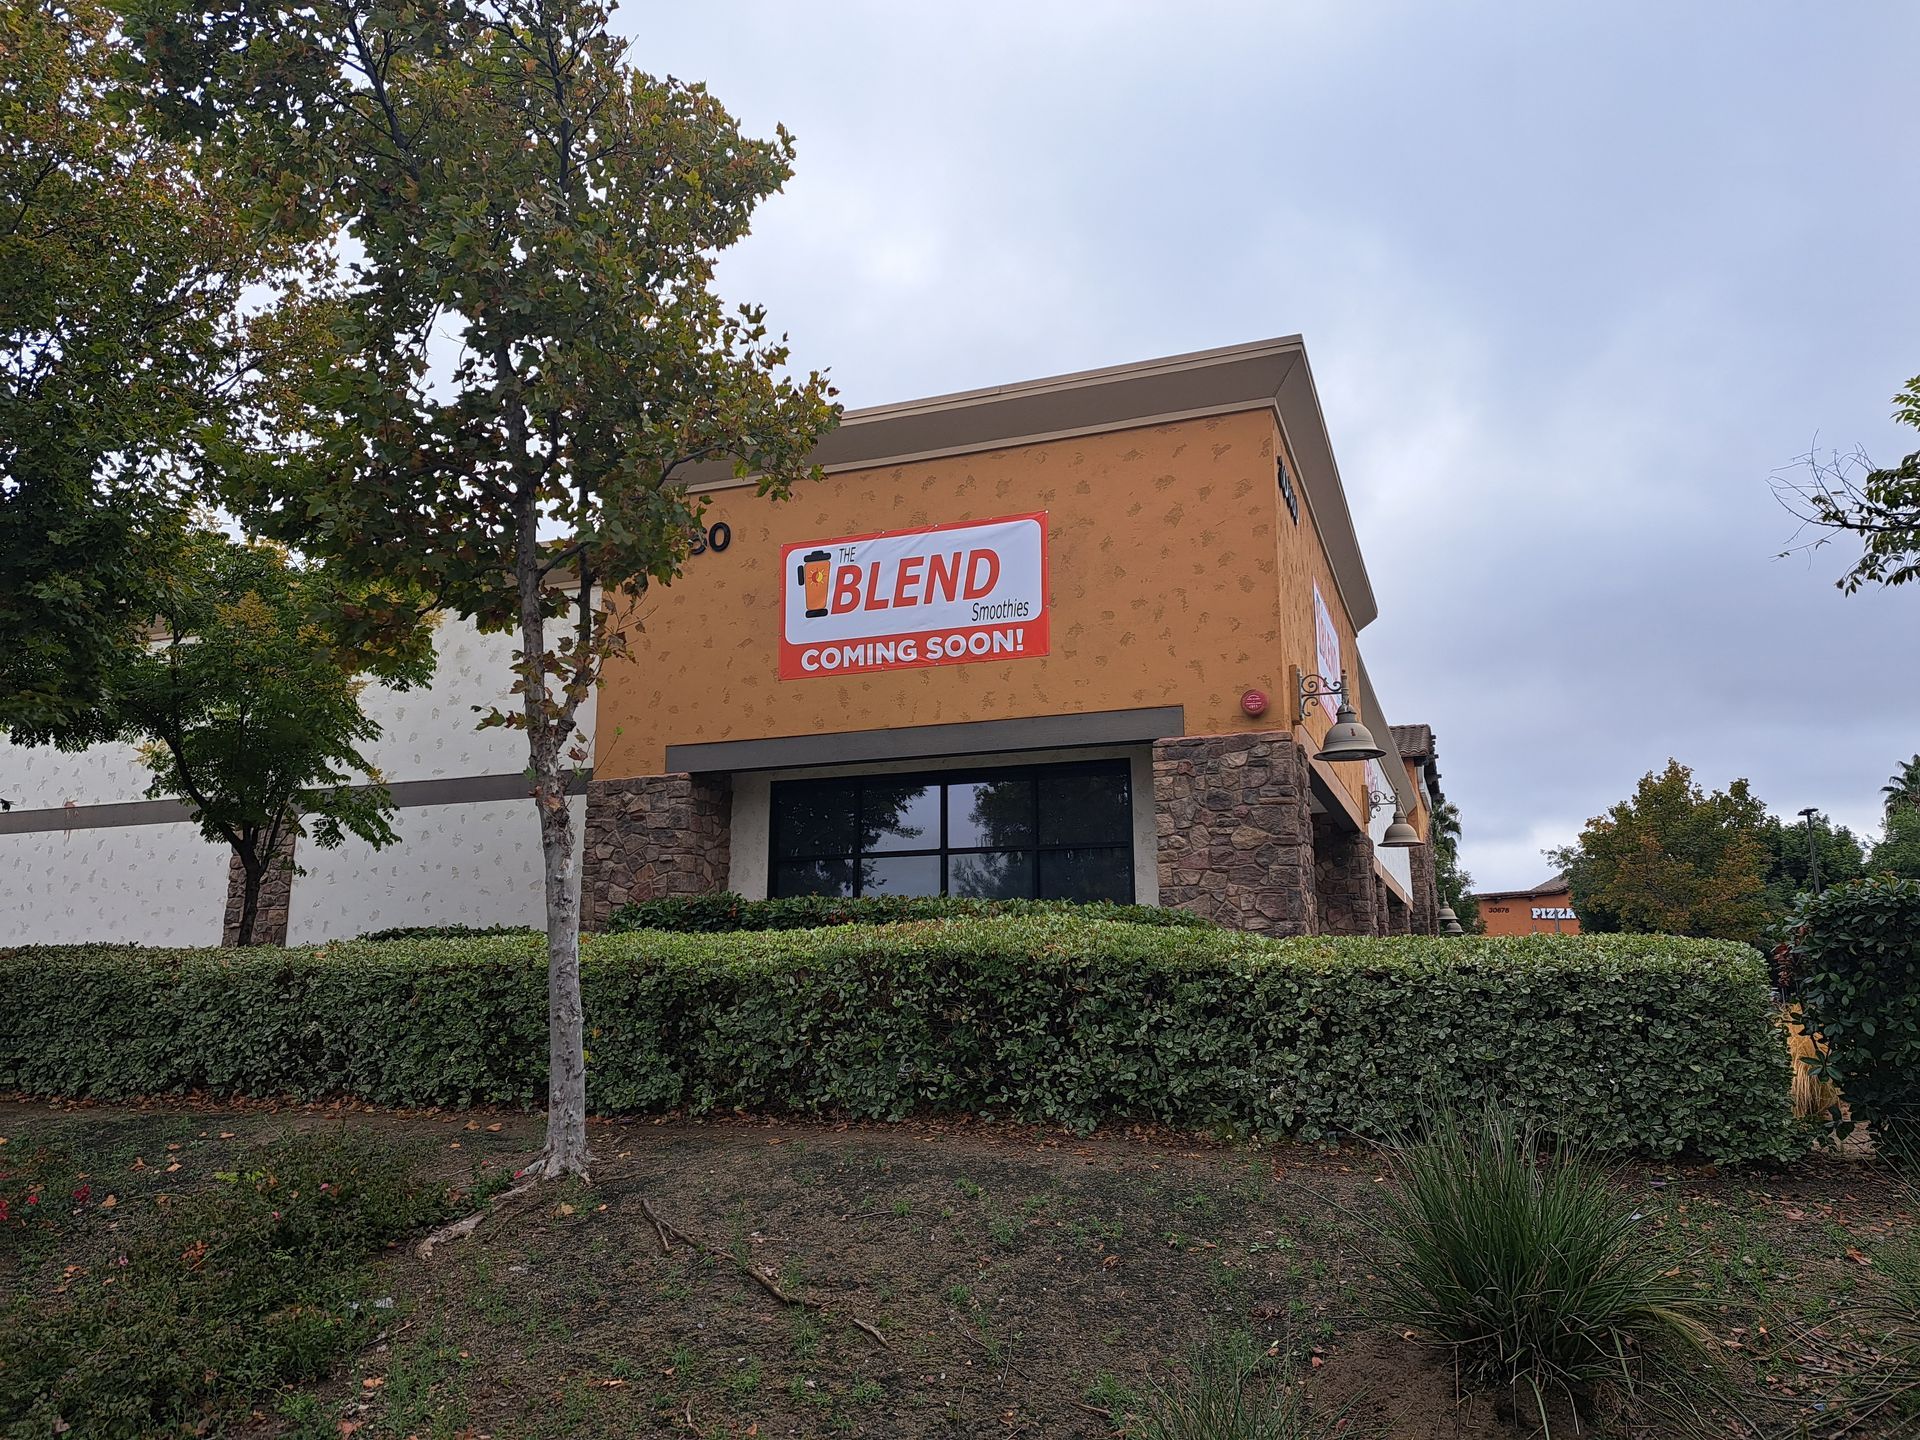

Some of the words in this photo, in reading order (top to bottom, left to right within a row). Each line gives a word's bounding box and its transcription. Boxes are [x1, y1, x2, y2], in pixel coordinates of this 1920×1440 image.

[839, 547, 856, 563] THE
[831, 548, 1000, 615] BLEND
[971, 598, 1029, 621] Smoothies
[801, 639, 918, 671] COMING
[926, 629, 1024, 660] SOON!
[1531, 907, 1577, 919] PIZZA
